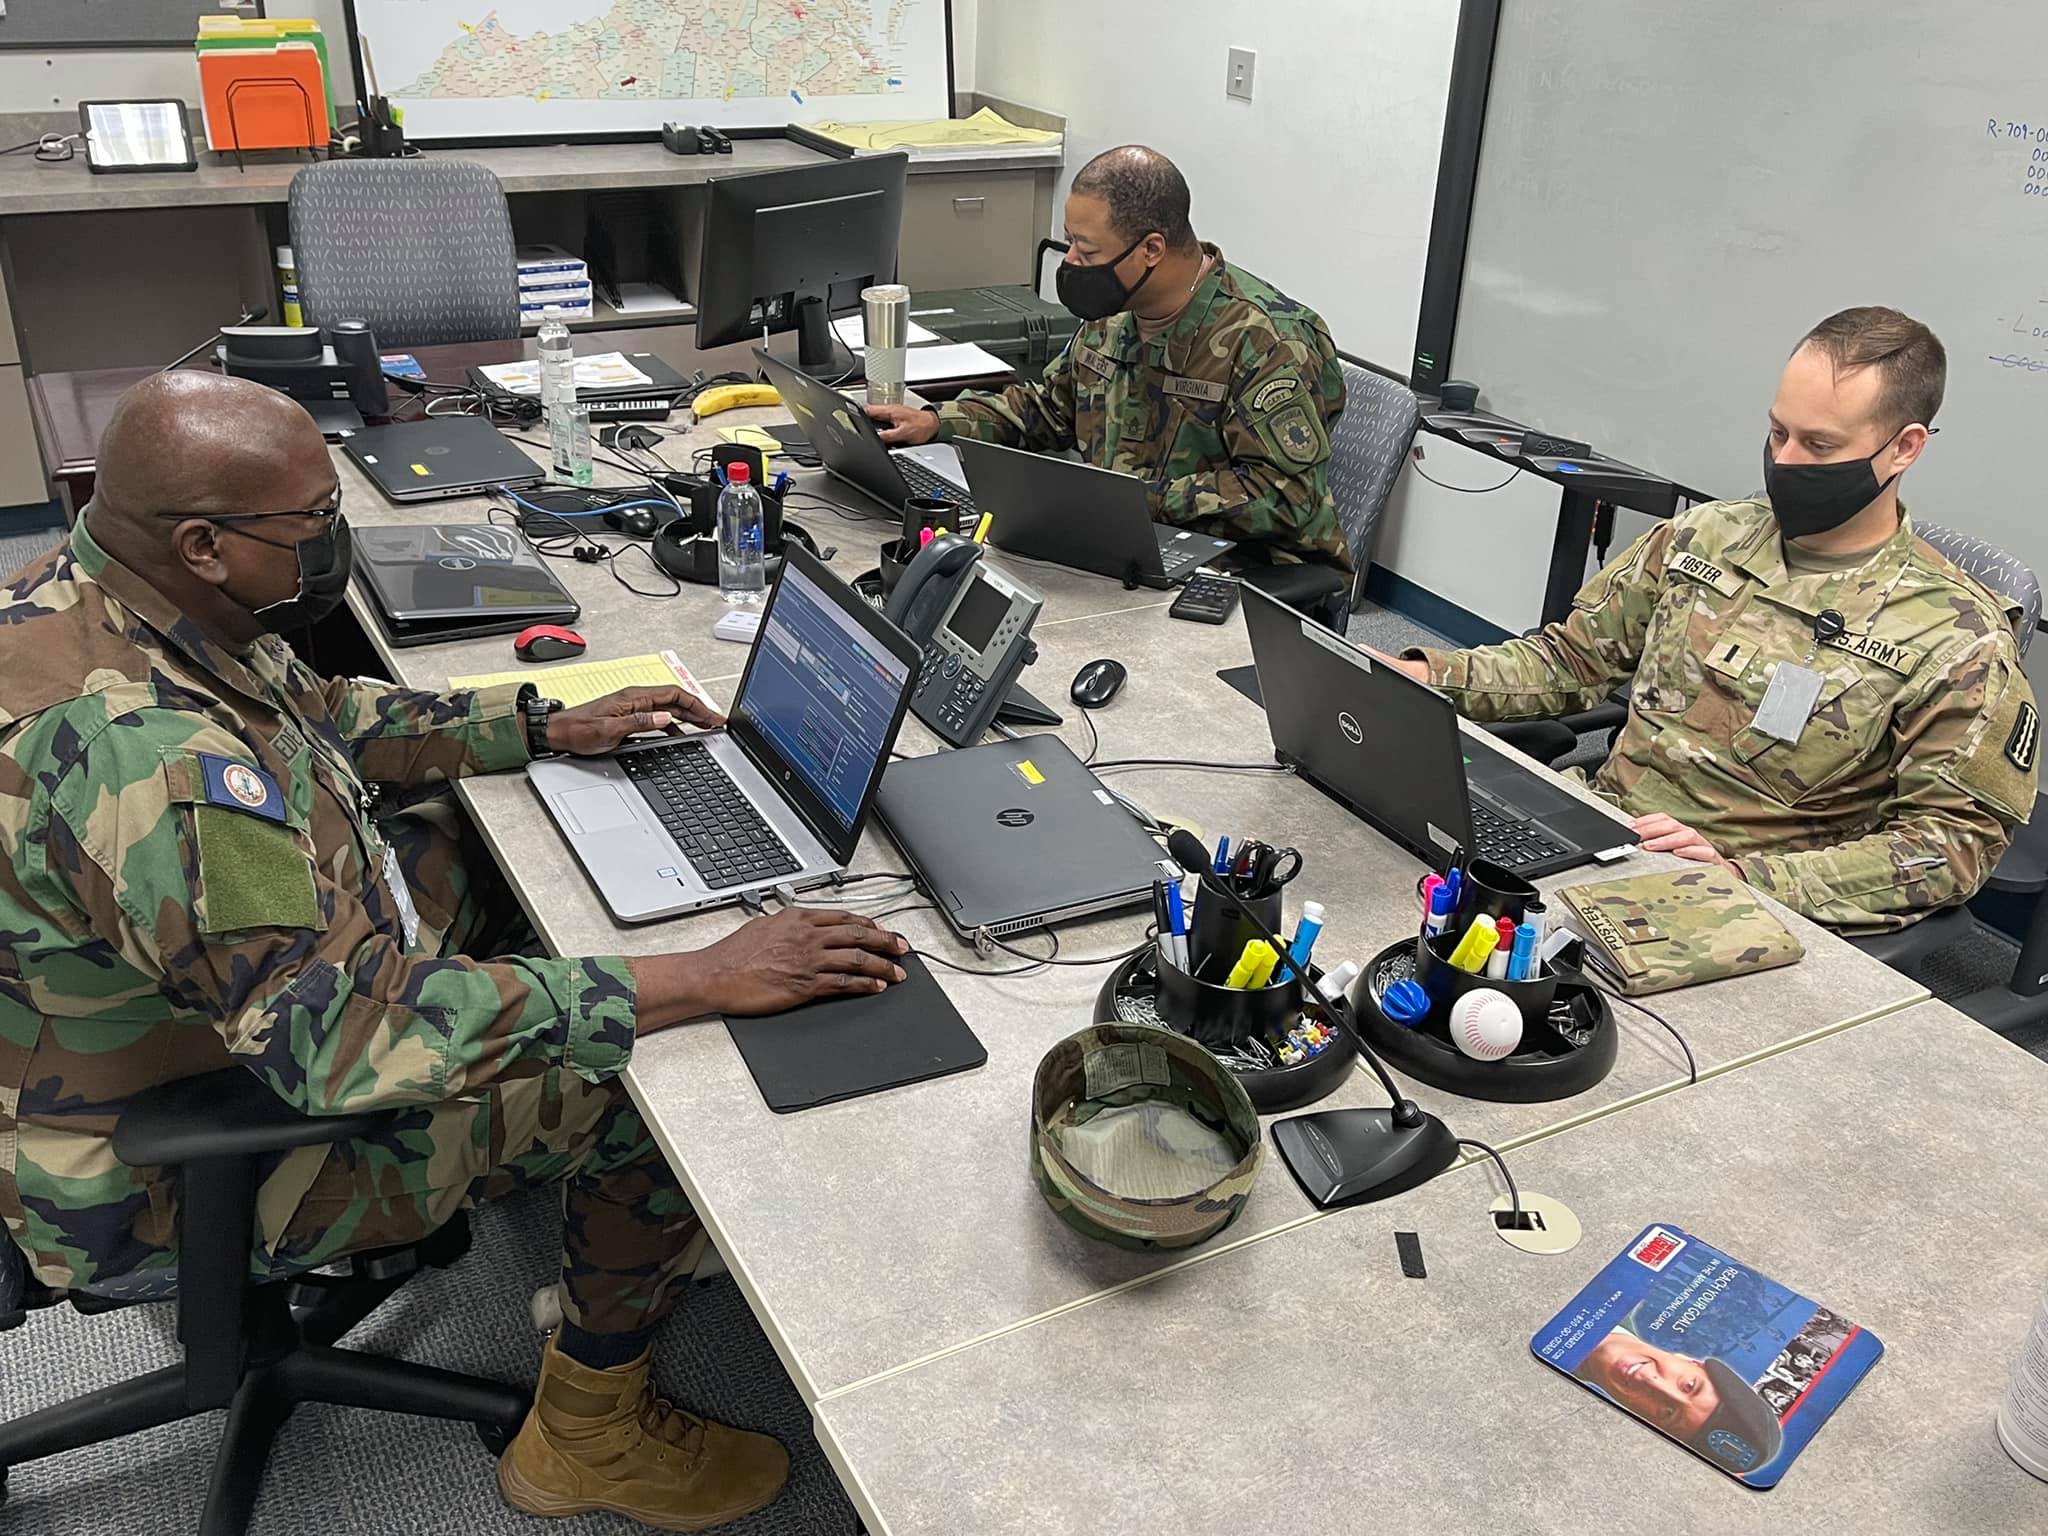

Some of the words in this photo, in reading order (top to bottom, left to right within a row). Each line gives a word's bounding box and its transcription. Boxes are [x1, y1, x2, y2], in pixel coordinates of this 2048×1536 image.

[1987, 118, 2048, 143] R-709-0
[1174, 379, 1210, 397] VIRGINIA
[1678, 554, 1723, 584] FOSTER
[1853, 636, 1909, 666] ARMY
[1581, 905, 1623, 951] FOSTER
[1710, 1266, 1739, 1292] REACH
[1692, 1288, 1719, 1311] YOUR
[1672, 1307, 1701, 1334] GOALS
